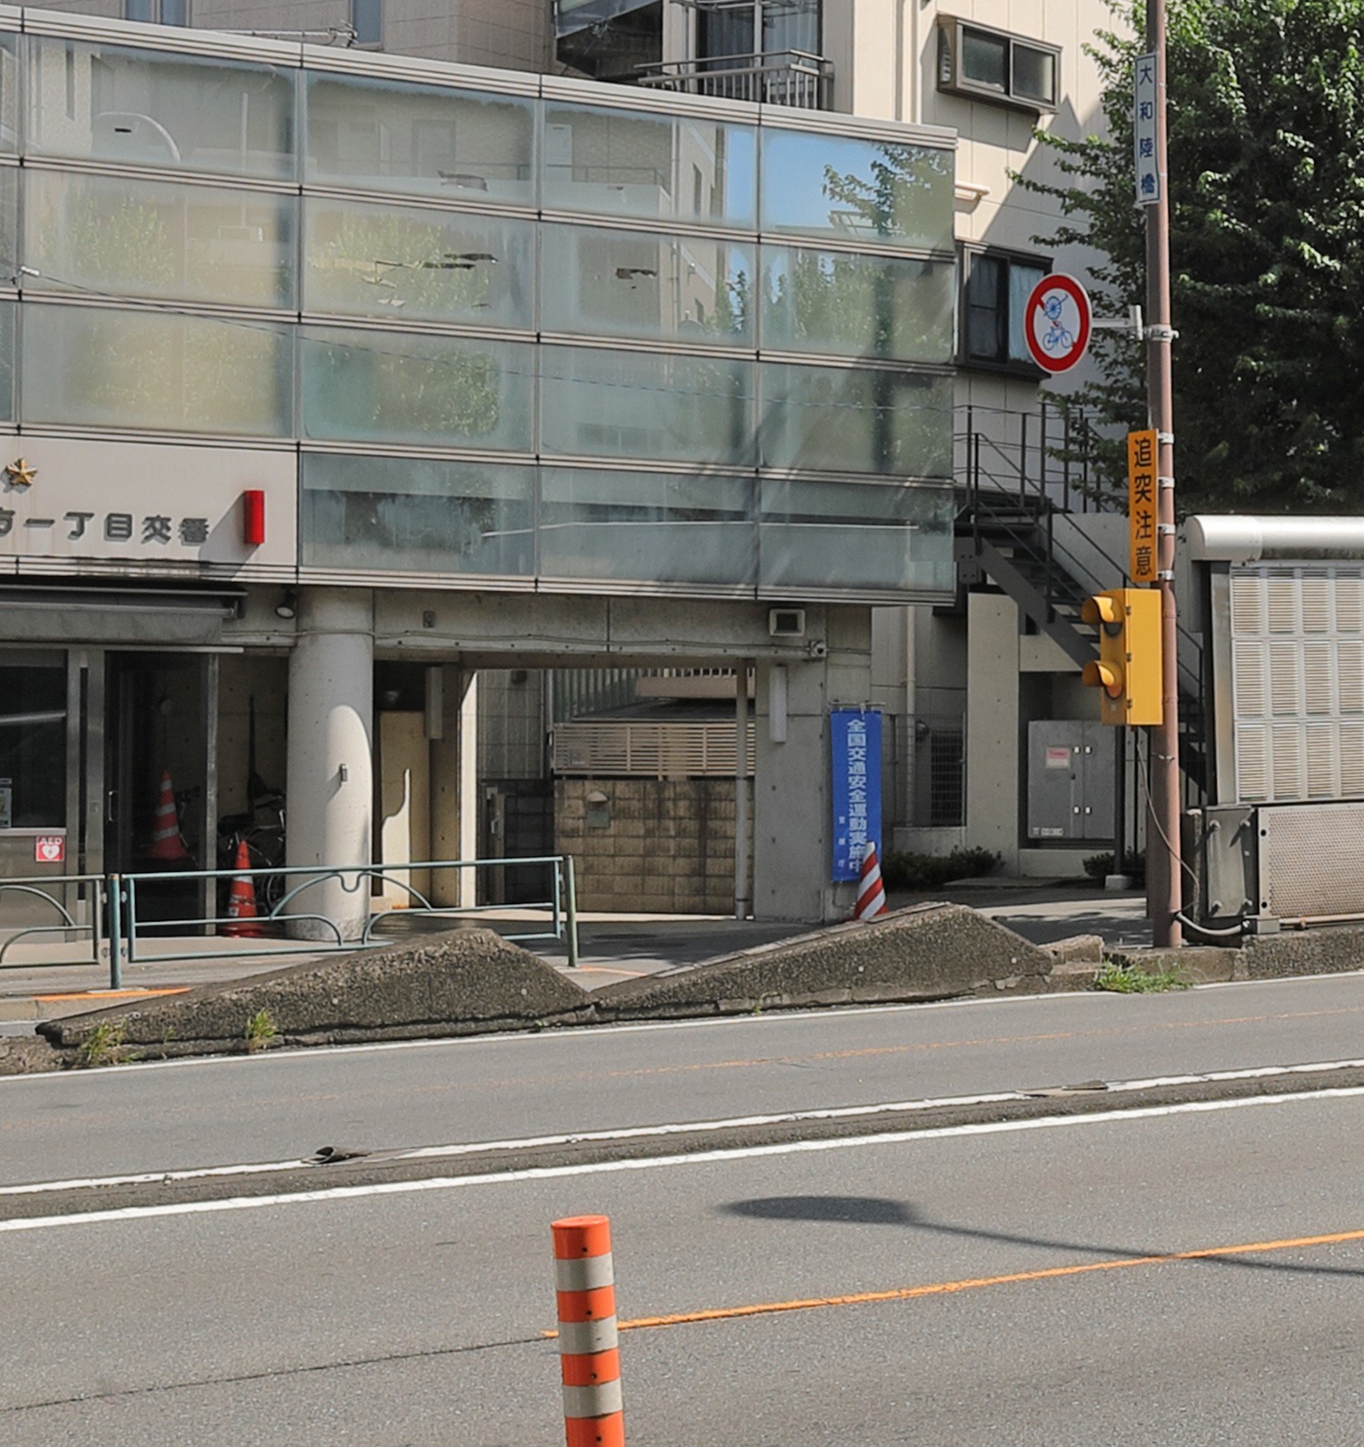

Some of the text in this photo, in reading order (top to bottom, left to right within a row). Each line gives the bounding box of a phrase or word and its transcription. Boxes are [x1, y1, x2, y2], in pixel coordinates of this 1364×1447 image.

[1139, 65, 1155, 194] 大和陸橋
[1134, 437, 1153, 576] 追突注意
[40, 837, 62, 845] AED
